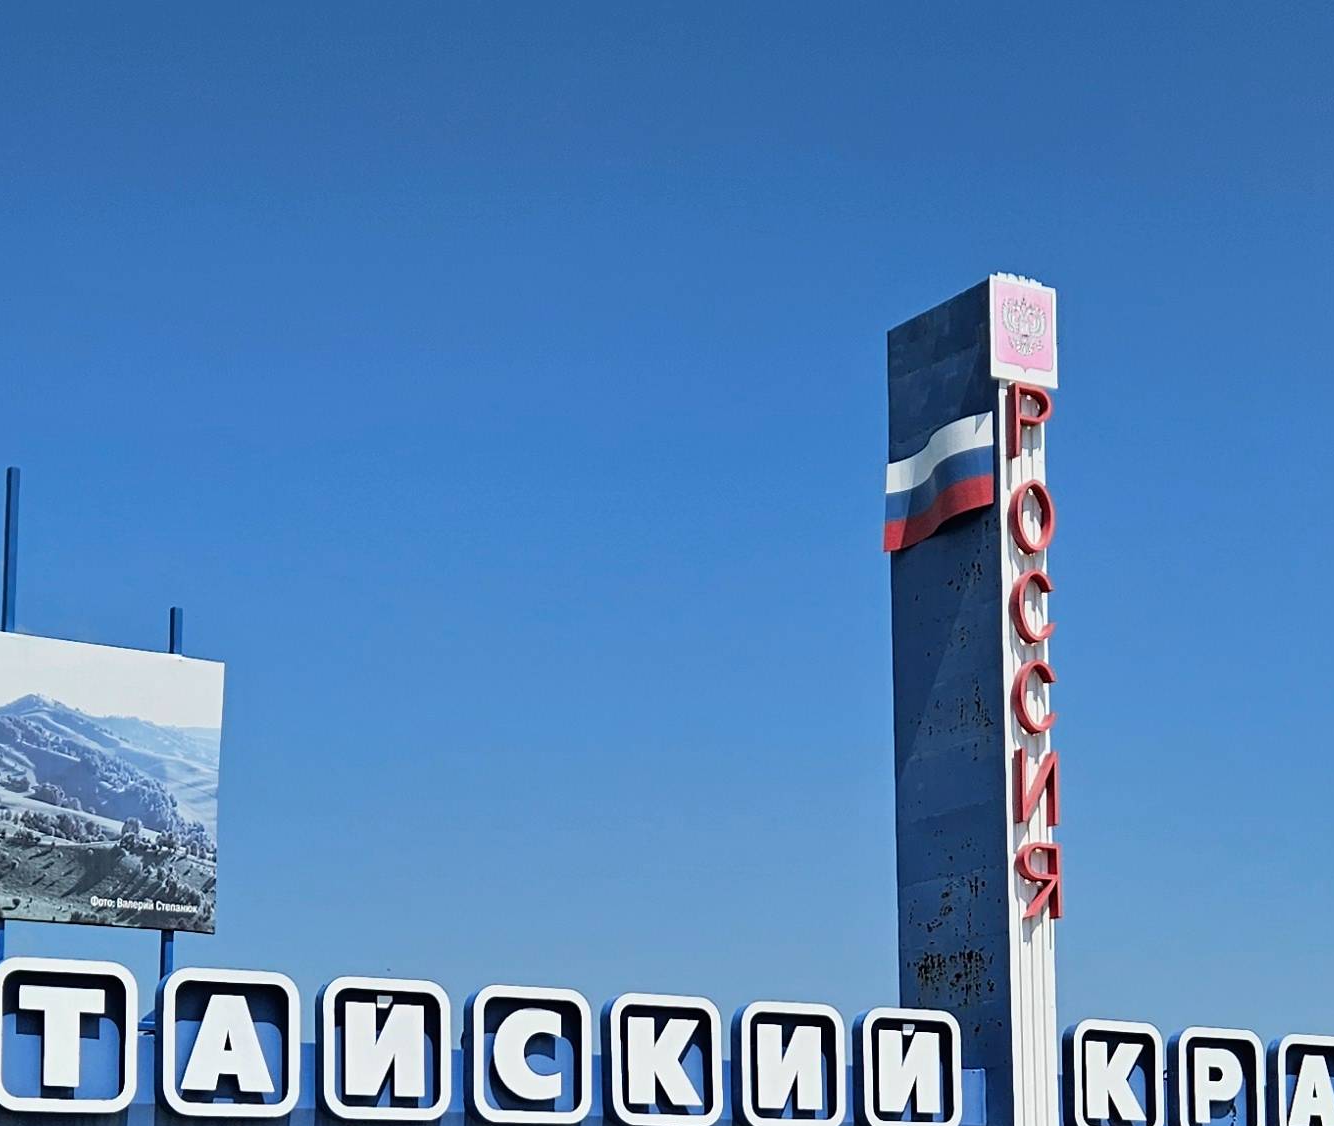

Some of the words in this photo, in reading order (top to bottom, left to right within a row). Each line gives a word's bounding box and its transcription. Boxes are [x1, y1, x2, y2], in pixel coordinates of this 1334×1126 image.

[1007, 382, 1061, 920] РОССИЯ
[90, 895, 115, 908] Фото:
[117, 897, 154, 911] Валерий
